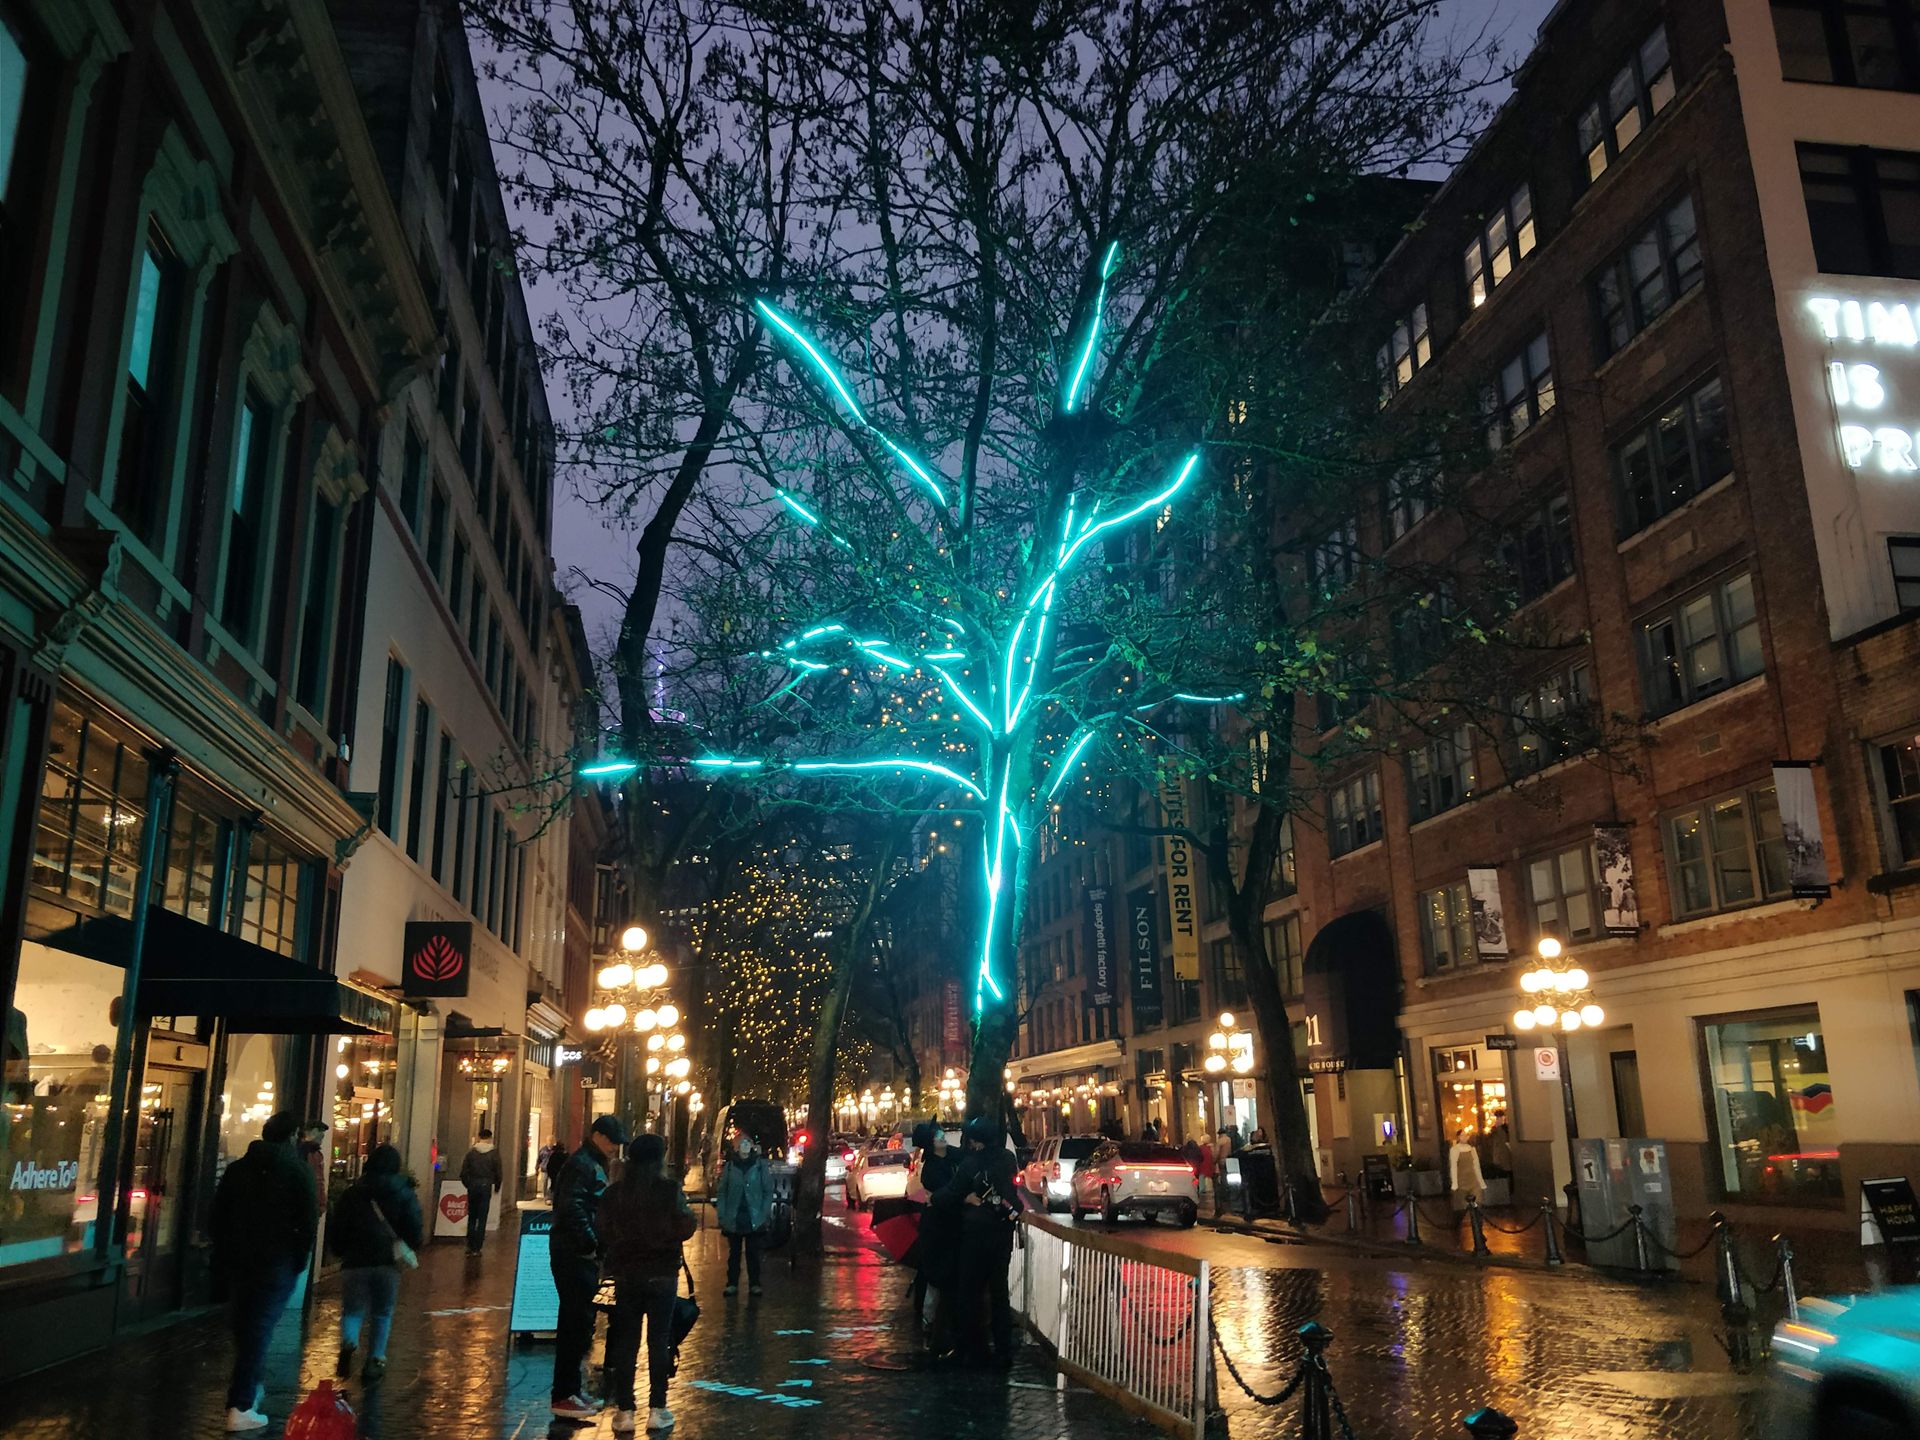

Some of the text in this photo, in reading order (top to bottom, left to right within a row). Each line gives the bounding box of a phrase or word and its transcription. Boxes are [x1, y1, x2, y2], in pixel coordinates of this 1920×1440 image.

[1807, 297, 1920, 346] TIM
[1829, 361, 1885, 409] IS
[1839, 425, 1920, 471] PR
[1170, 838, 1188, 878] FOR
[1093, 903, 1107, 948] spaghetti
[1173, 884, 1193, 937] RENT
[1097, 950, 1108, 988] factory
[1136, 907, 1152, 989] FILSON
